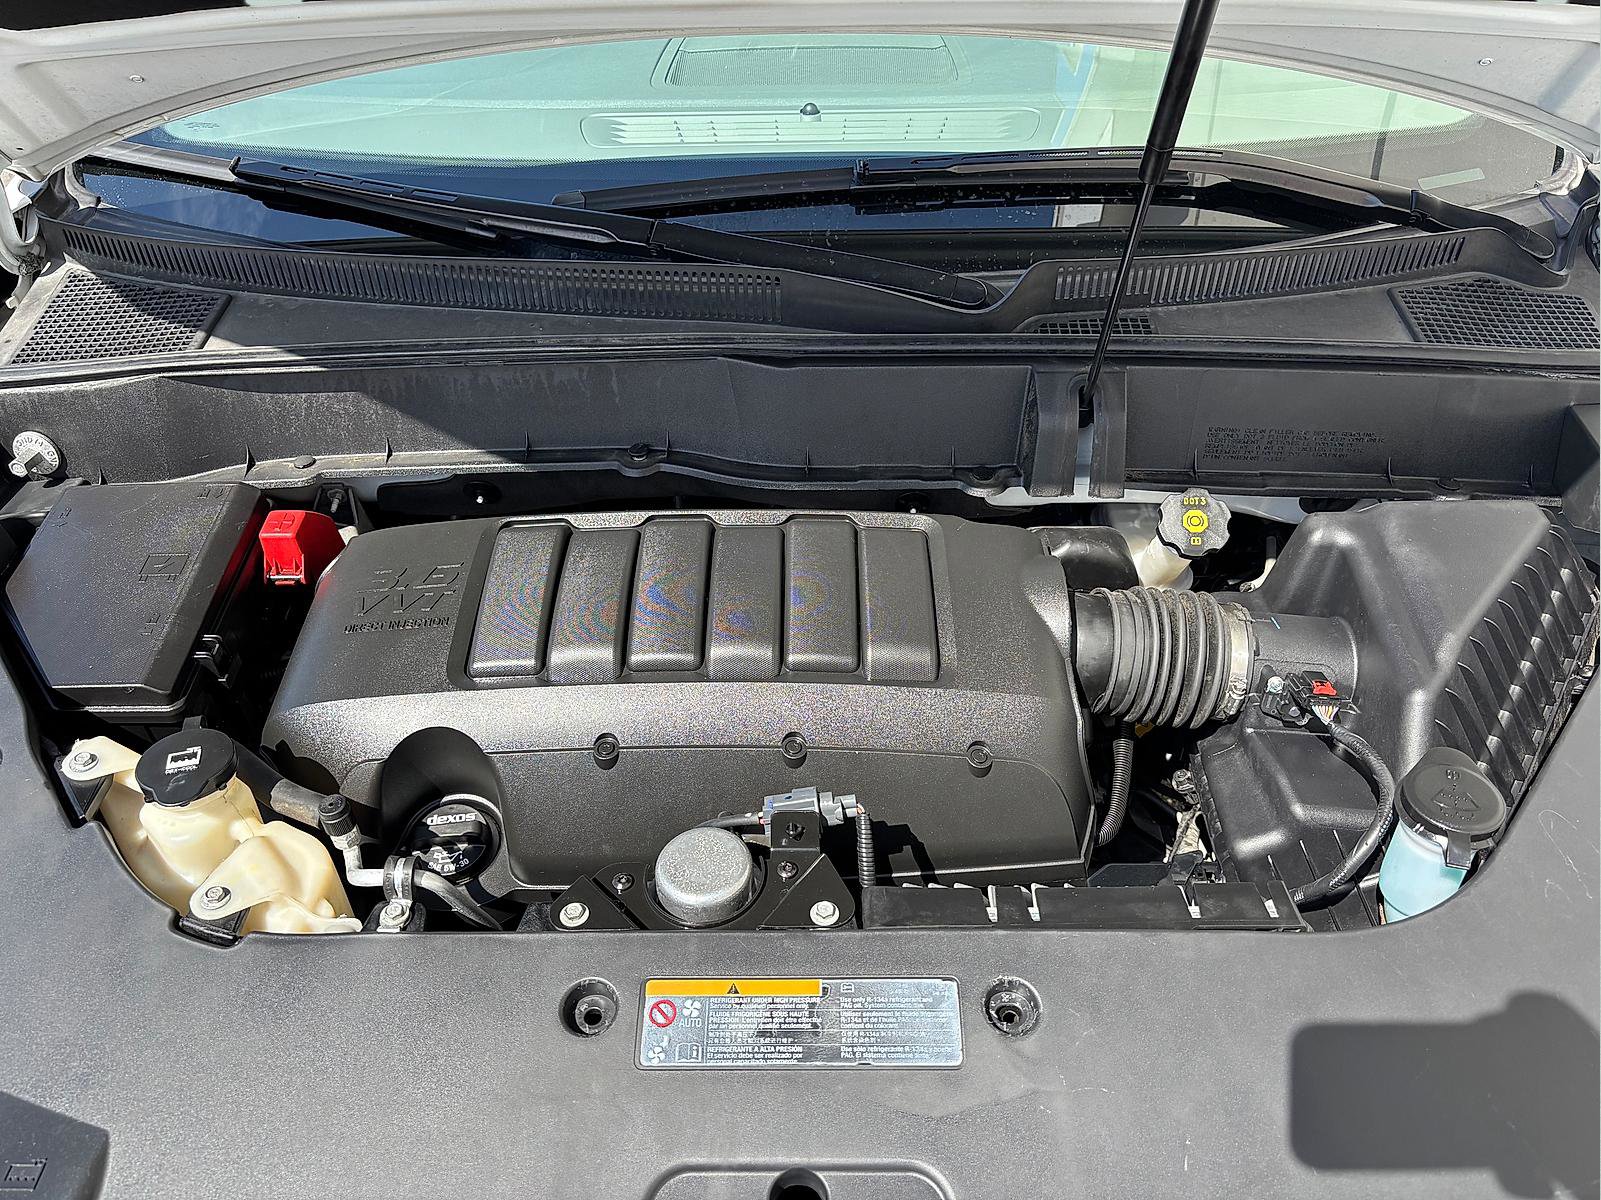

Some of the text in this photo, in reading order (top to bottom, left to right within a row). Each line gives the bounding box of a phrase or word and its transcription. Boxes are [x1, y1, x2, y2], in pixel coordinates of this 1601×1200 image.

[1183, 496, 1207, 506] DOT 3
[343, 616, 450, 634] DIRECT INJECTION
[426, 812, 478, 826] dexos
[678, 1018, 702, 1028] AUTO
